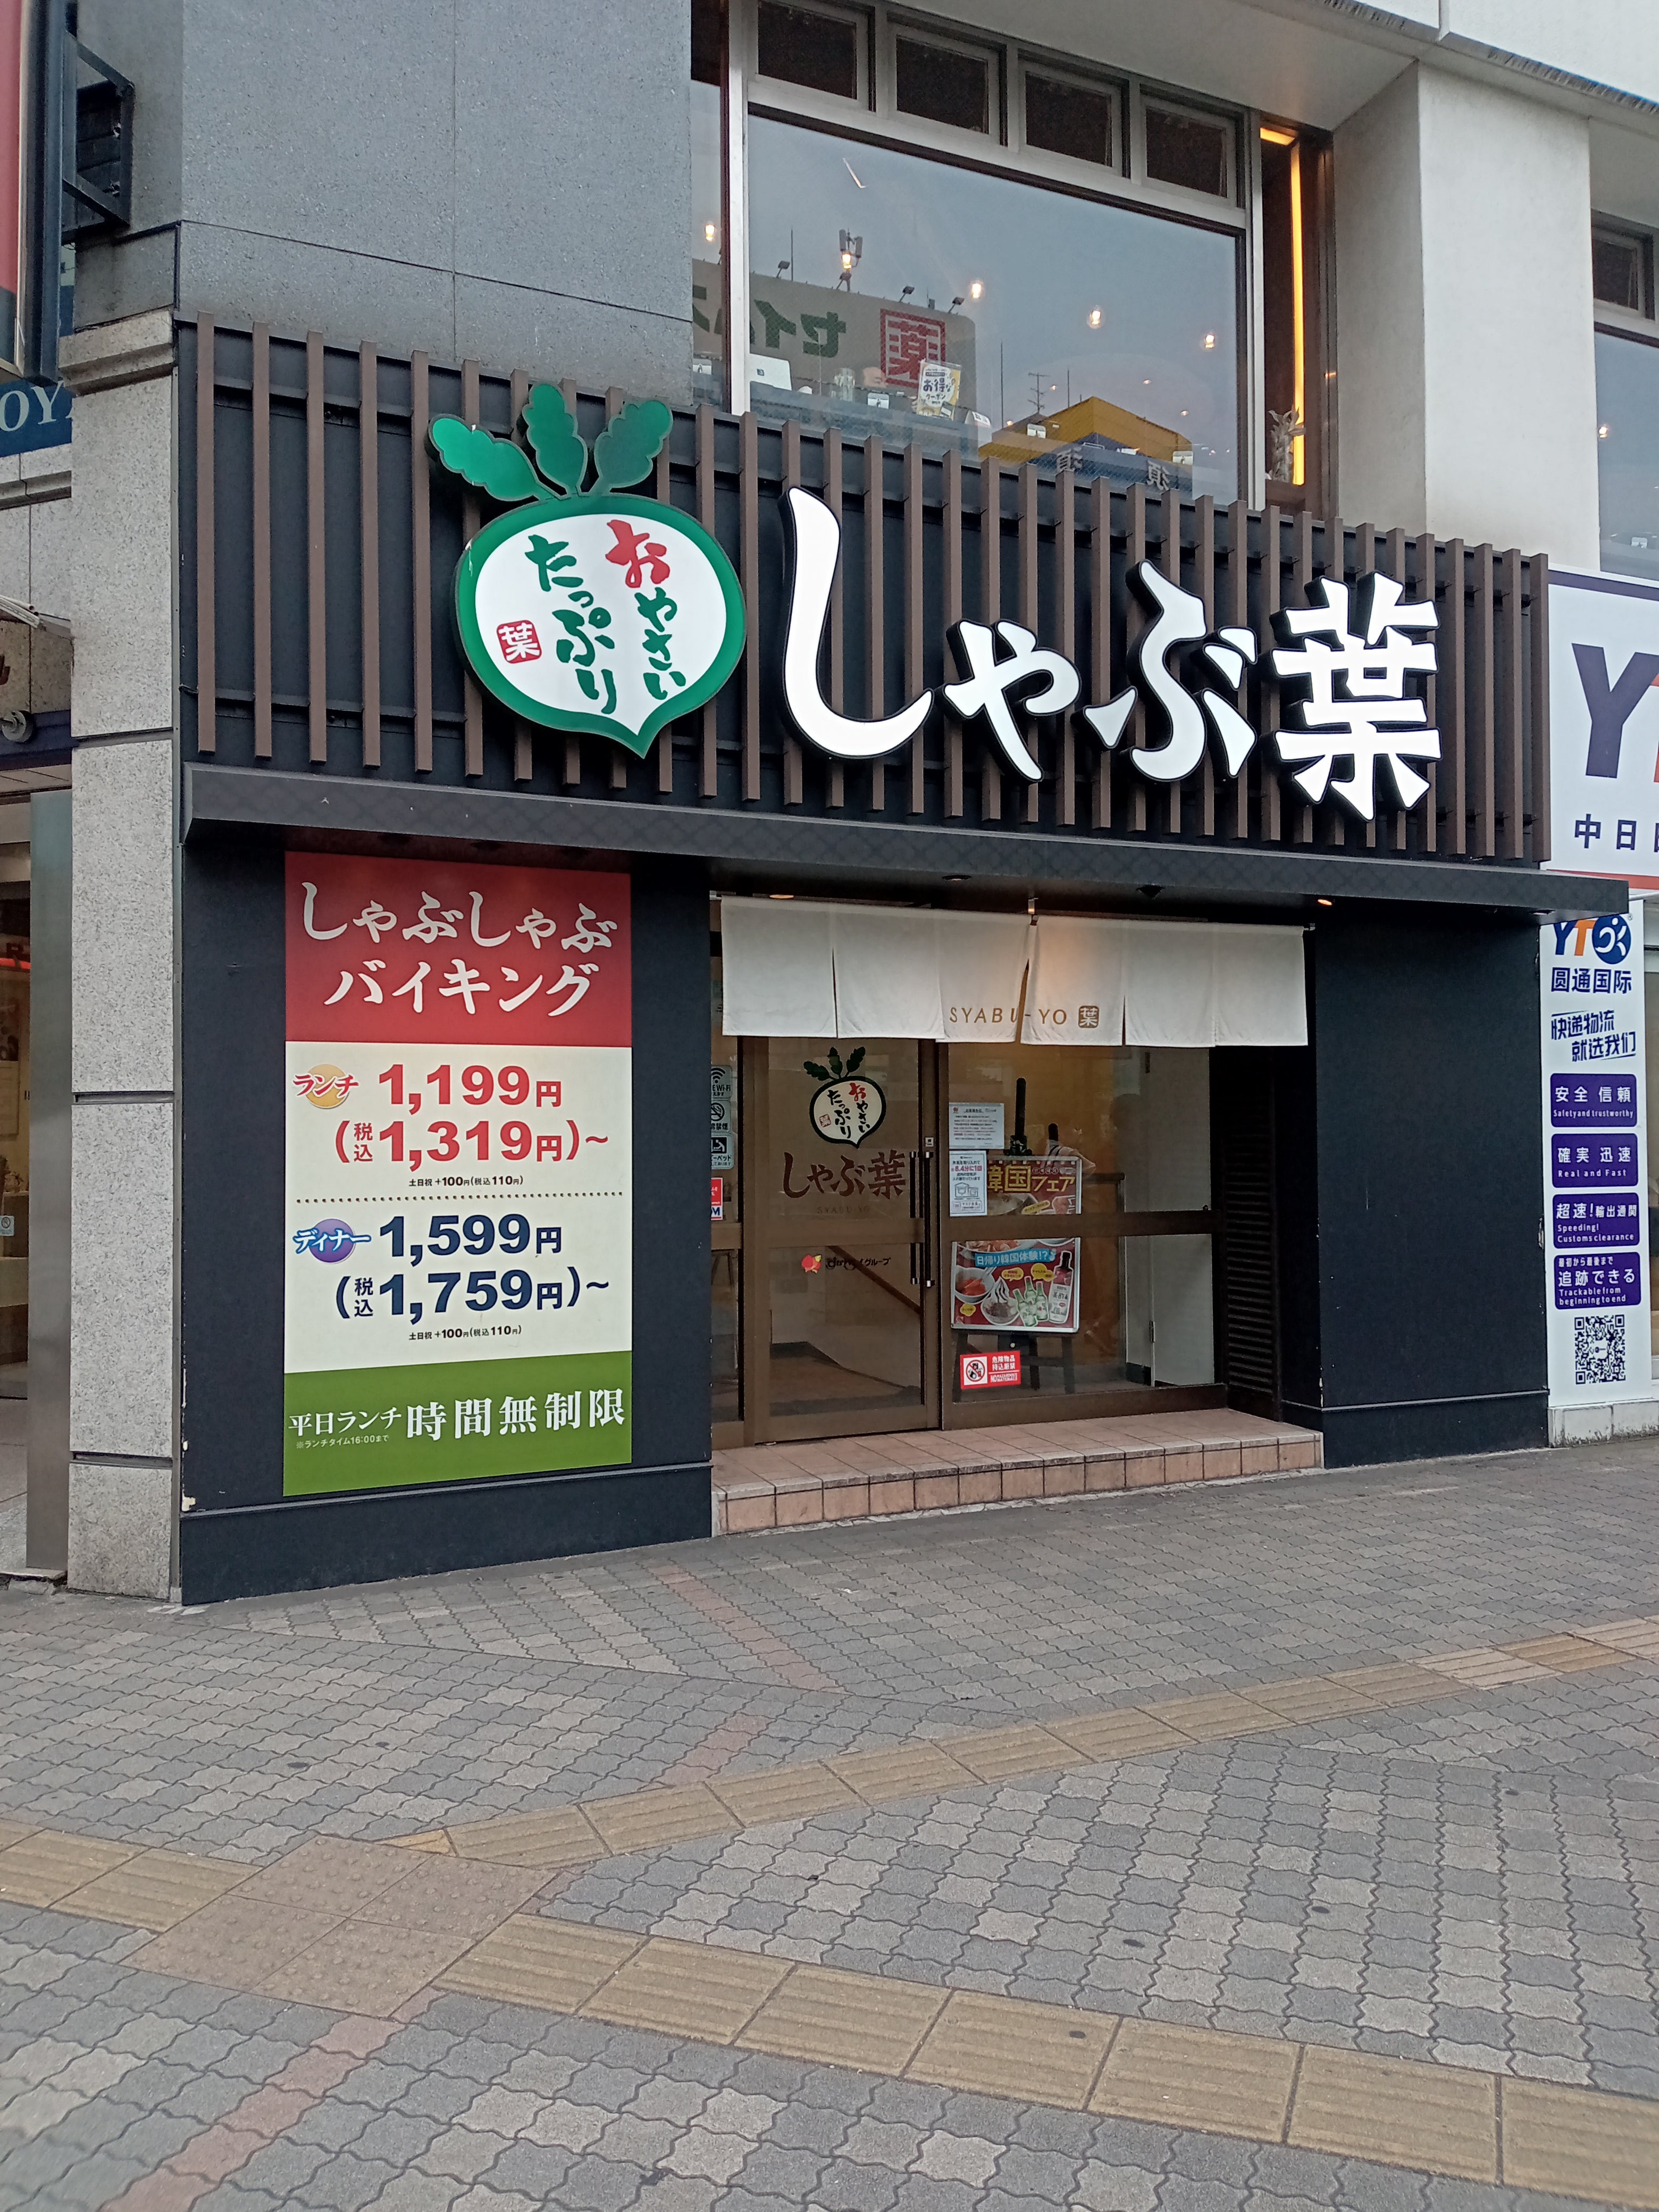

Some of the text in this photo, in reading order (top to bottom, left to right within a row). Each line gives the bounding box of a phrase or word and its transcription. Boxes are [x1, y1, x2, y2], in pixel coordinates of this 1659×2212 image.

[0, 381, 72, 432] OY
[524, 534, 617, 714] たっぷり
[606, 519, 686, 700] おやさい
[498, 622, 541, 663] 葉
[782, 486, 1442, 822] しゃぶ葉
[1572, 643, 1659, 783] Y
[301, 882, 617, 953] しゃぶしゃぶ
[323, 959, 599, 1017] バイキング
[1551, 967, 1632, 994] 圆通国际
[1078, 1005, 1099, 1029] 葉
[1551, 1010, 1615, 1041] 快递物流
[1571, 1031, 1636, 1062] 就选我们
[293, 1064, 562, 1115] ランチ 1,199円
[827, 1090, 851, 1138] たっぷり
[849, 1083, 870, 1133] おやさい
[1555, 1086, 1631, 1103] 安全 信頼
[783, 1149, 906, 1200] しゃぶ葉
[1557, 1146, 1630, 1163] 確実 迅速
[293, 1213, 562, 1267] ディナー 1,599円
[1559, 1269, 1635, 1287] 追跡できる
[1559, 1287, 1601, 1296] Trackable
[1559, 1297, 1600, 1306] beginning
[288, 1388, 625, 1441] 平日ランチ 時間無制限
